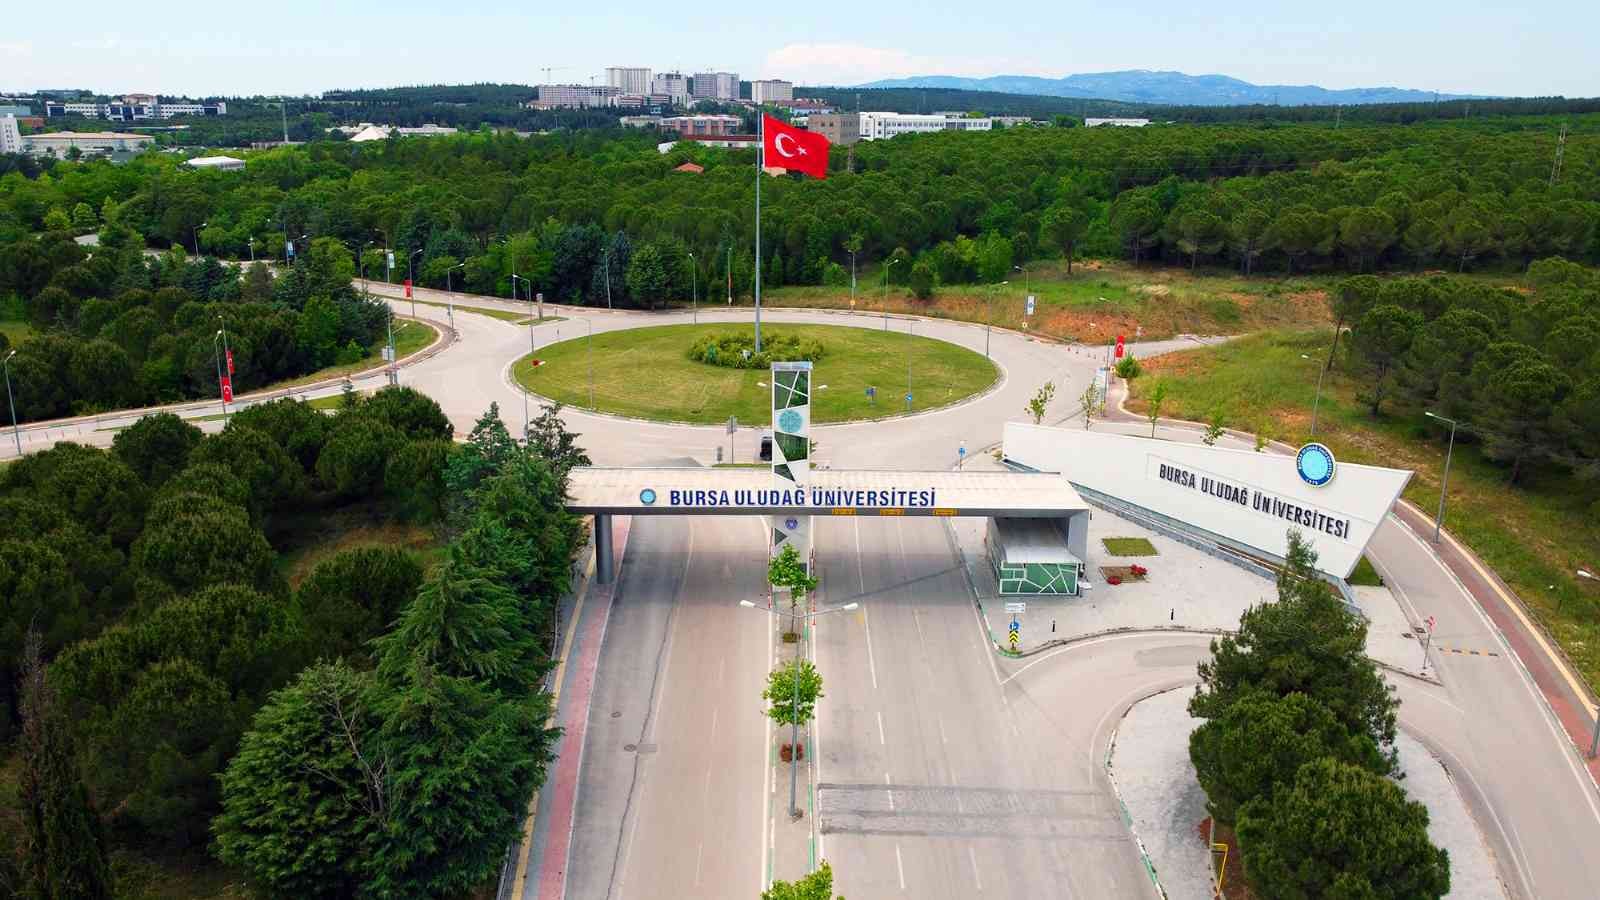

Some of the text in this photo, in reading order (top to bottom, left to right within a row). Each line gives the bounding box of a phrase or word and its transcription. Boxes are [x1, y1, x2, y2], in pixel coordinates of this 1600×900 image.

[670, 484, 936, 507] BURSA ULUDAĞ ÜNİVERSİTESİ
[1159, 463, 1351, 539] BURSA ULUDAĞ ÜNİVERSİTESİ
